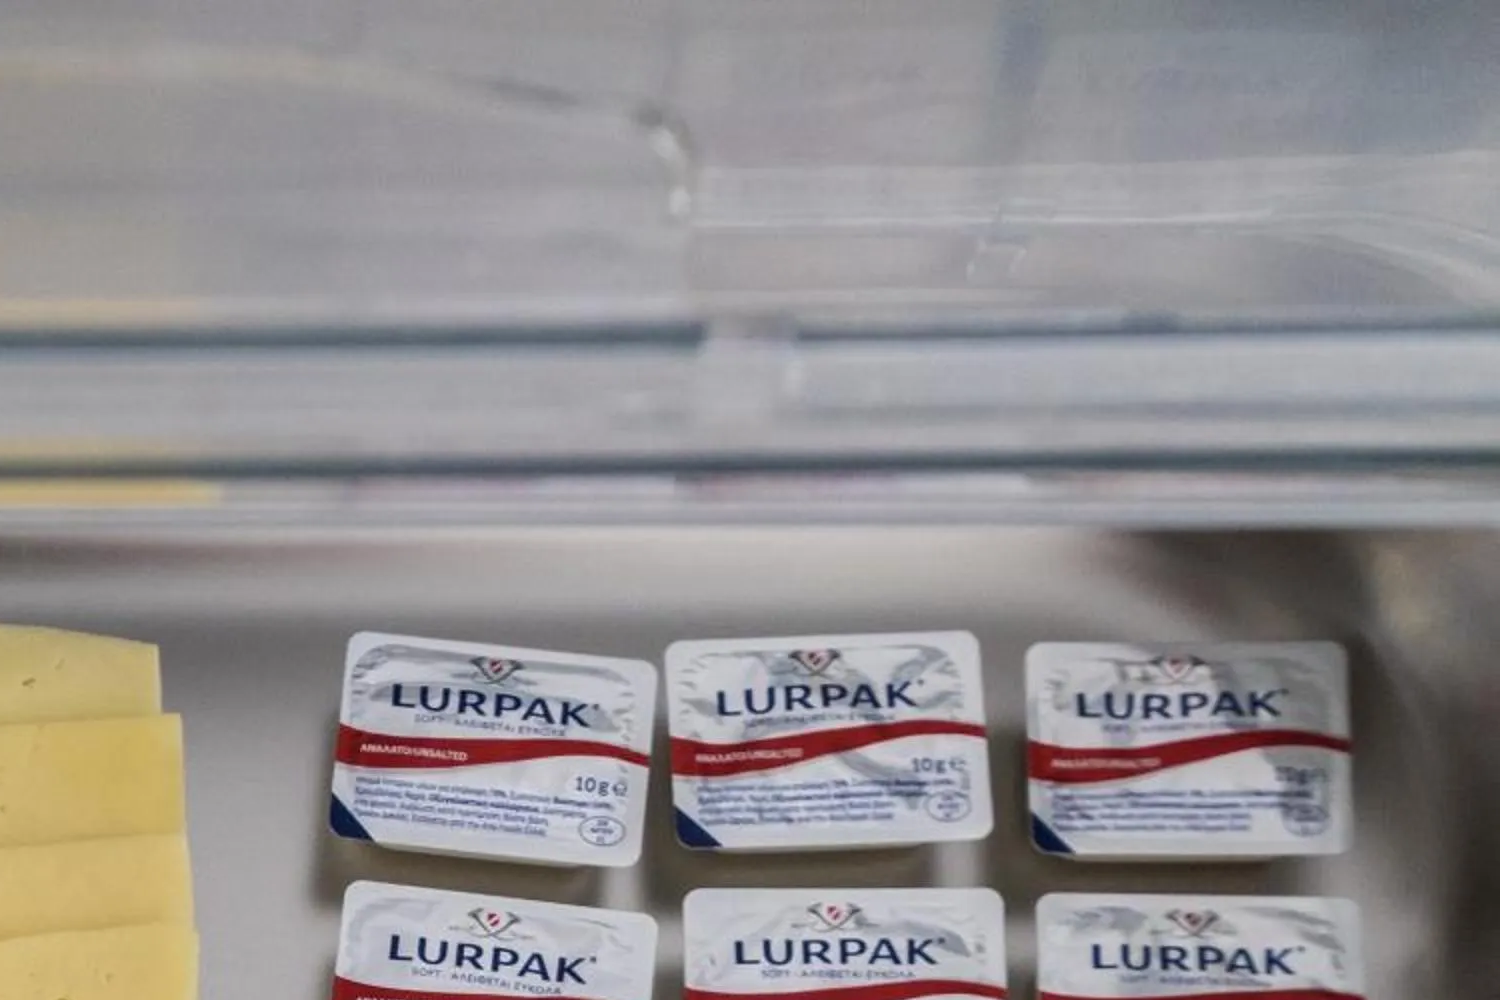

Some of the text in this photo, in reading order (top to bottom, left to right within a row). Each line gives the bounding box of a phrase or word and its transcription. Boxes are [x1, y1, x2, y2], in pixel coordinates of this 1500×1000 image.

[392, 683, 591, 728] LURPAK
[716, 680, 917, 717] LURPAK
[1076, 690, 1282, 720] LURPAK
[388, 934, 588, 985] LURPAK
[734, 937, 938, 966] LURPAK
[1091, 944, 1297, 976] LURPAK
